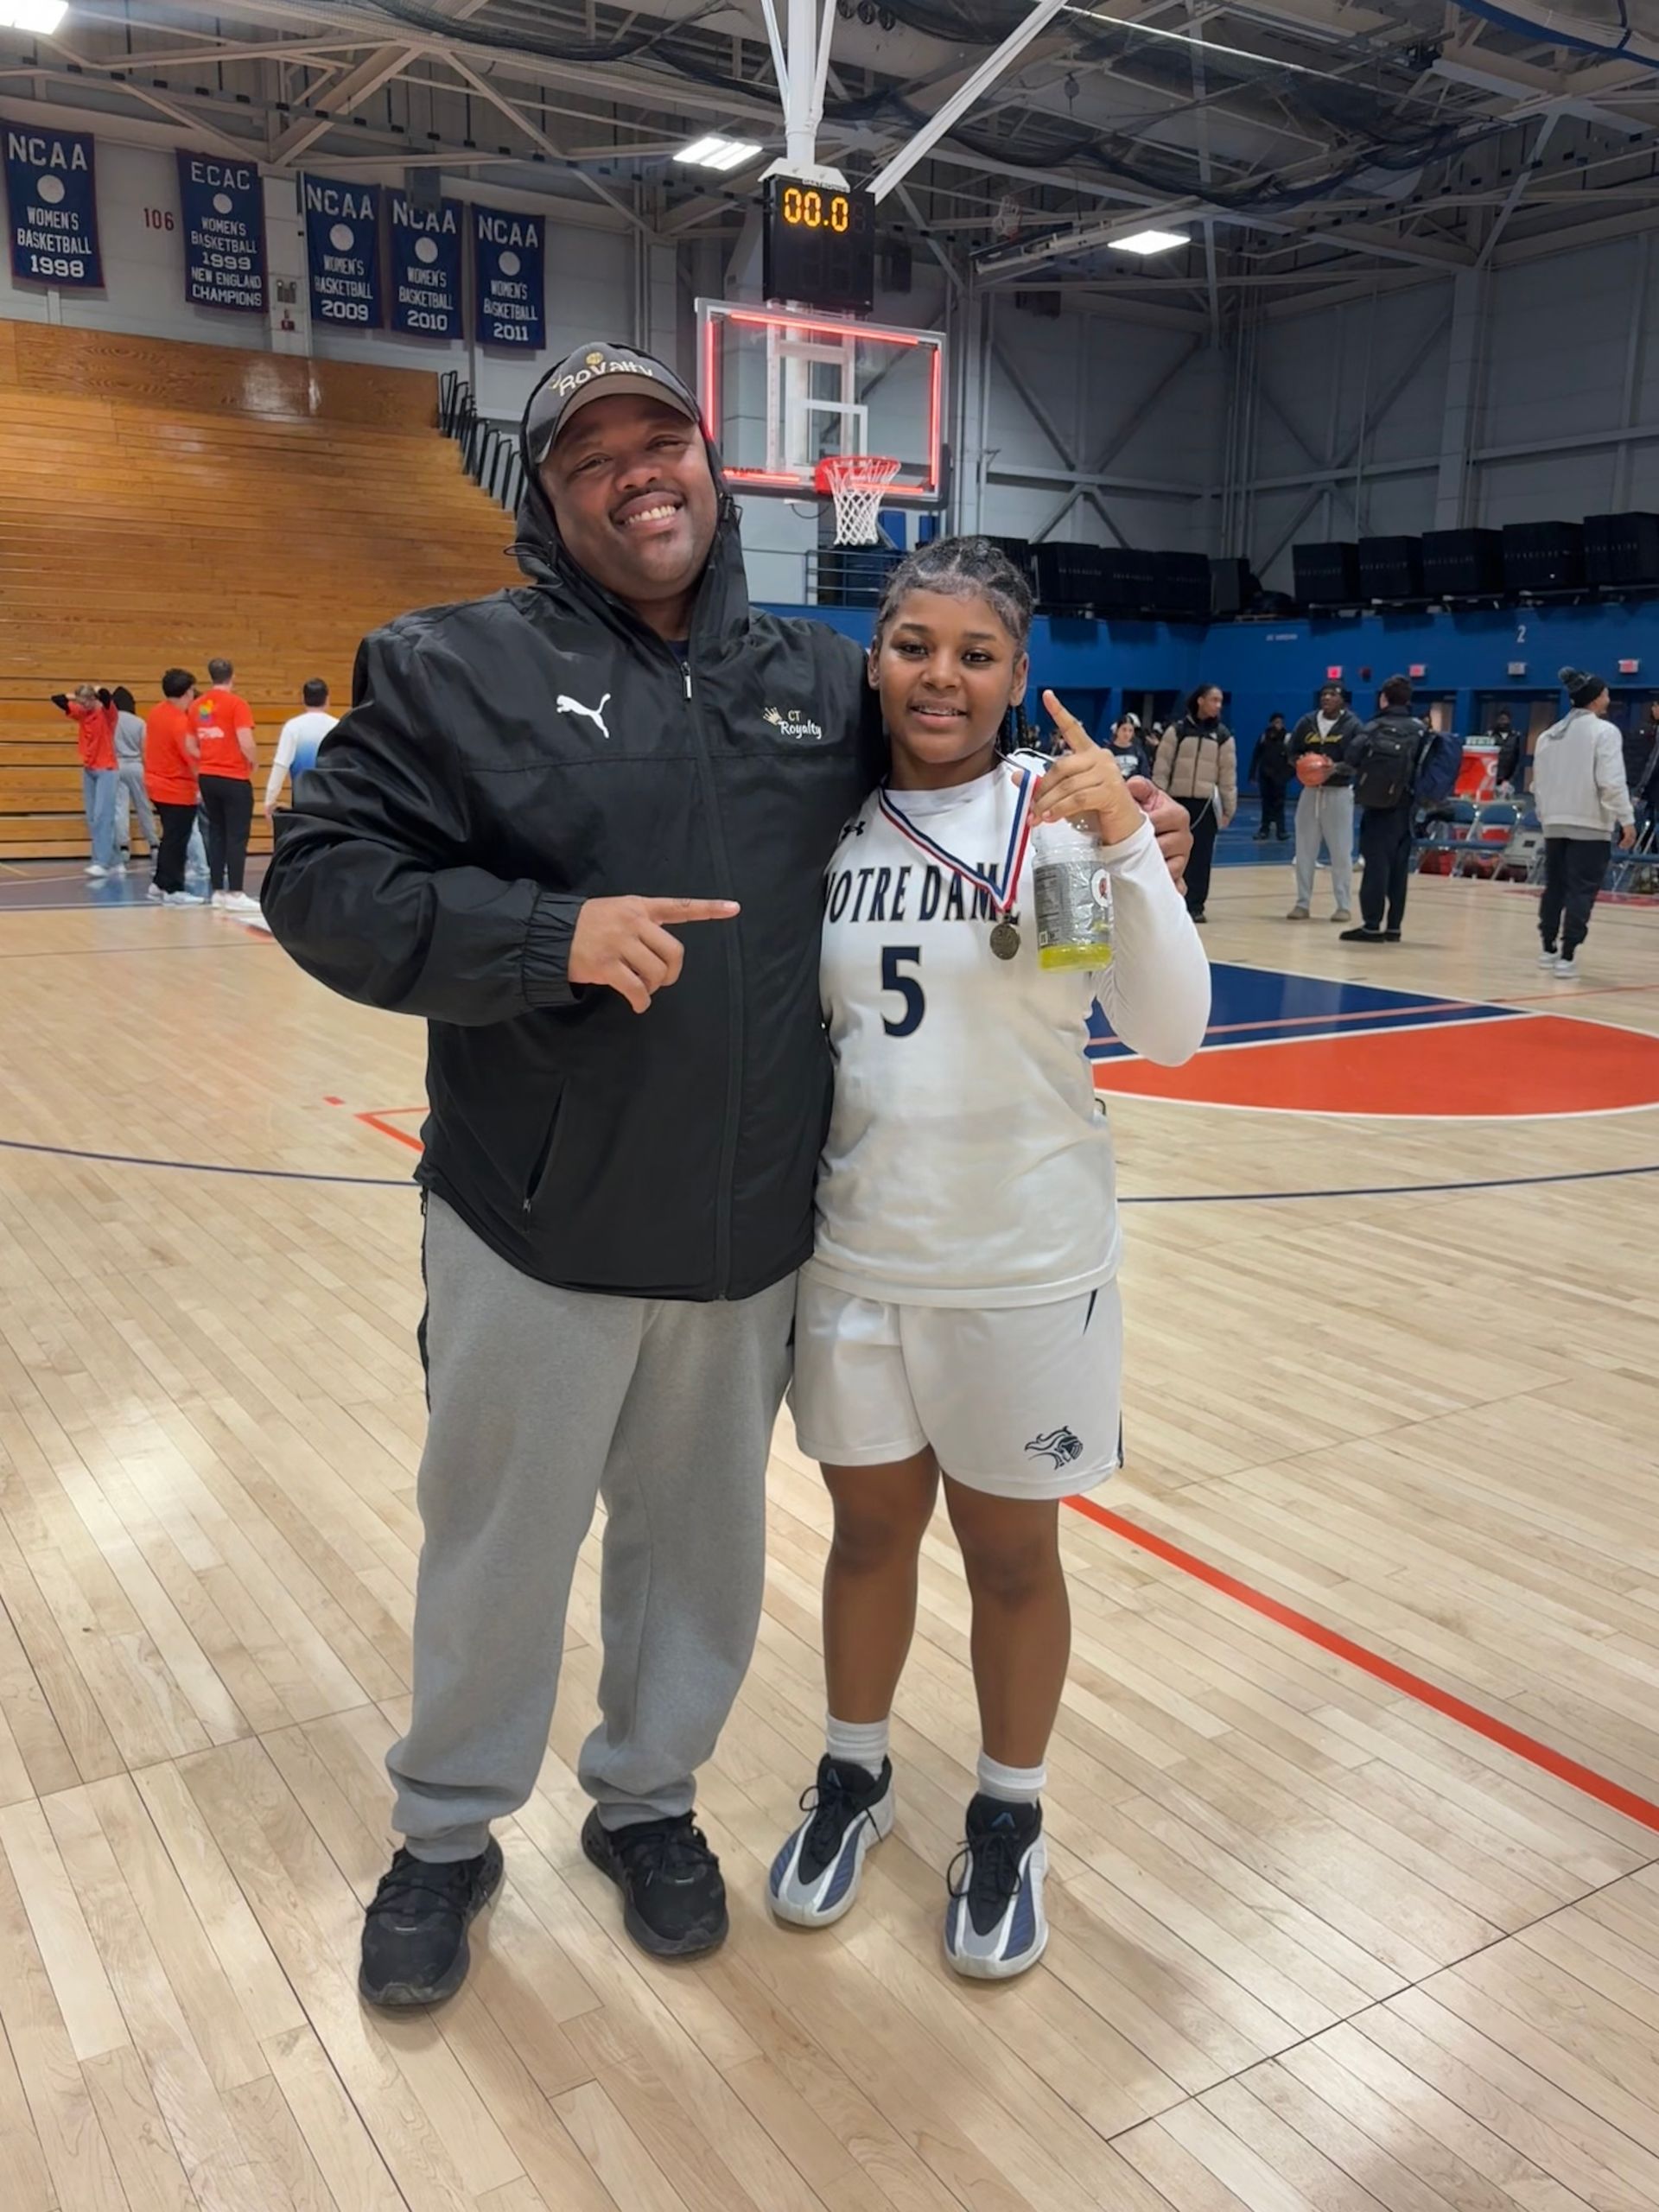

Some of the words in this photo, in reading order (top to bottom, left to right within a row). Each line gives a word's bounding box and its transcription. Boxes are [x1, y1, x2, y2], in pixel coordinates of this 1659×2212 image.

[9, 132, 87, 170] NCAA
[191, 162, 250, 190] ECAC
[307, 184, 374, 220] NCAA
[784, 188, 849, 232] 00.0
[27, 206, 79, 231] WOMEN'S
[143, 207, 175, 231] 106
[201, 216, 246, 237] WOMEN'S
[392, 199, 456, 234] NCAA
[17, 228, 92, 254] BASKETBALL
[191, 231, 257, 254] BASKETBALL
[479, 214, 538, 248] NCAA
[31, 255, 85, 278] 1998
[202, 251, 251, 270] 1999
[323, 255, 364, 276] WOMEN'S
[191, 266, 213, 283] NEW
[216, 271, 262, 289] ENGLAND
[315, 276, 373, 300] BASKETBALL
[407, 266, 447, 288] WOMEN'S
[193, 284, 262, 307] CHAMPIONS
[398, 286, 454, 310] BASKETBALL
[491, 280, 528, 301] WOMEN'S
[321, 300, 369, 321] 2009
[407, 309, 448, 331] 2010
[483, 298, 538, 321] BASKETBALL
[493, 322, 529, 341] 2011
[1516, 624, 1527, 643] 2
[787, 709, 801, 722] CT
[779, 719, 823, 740] Royalty
[918, 861, 1021, 926] DAM
[881, 945, 926, 1038] 5
